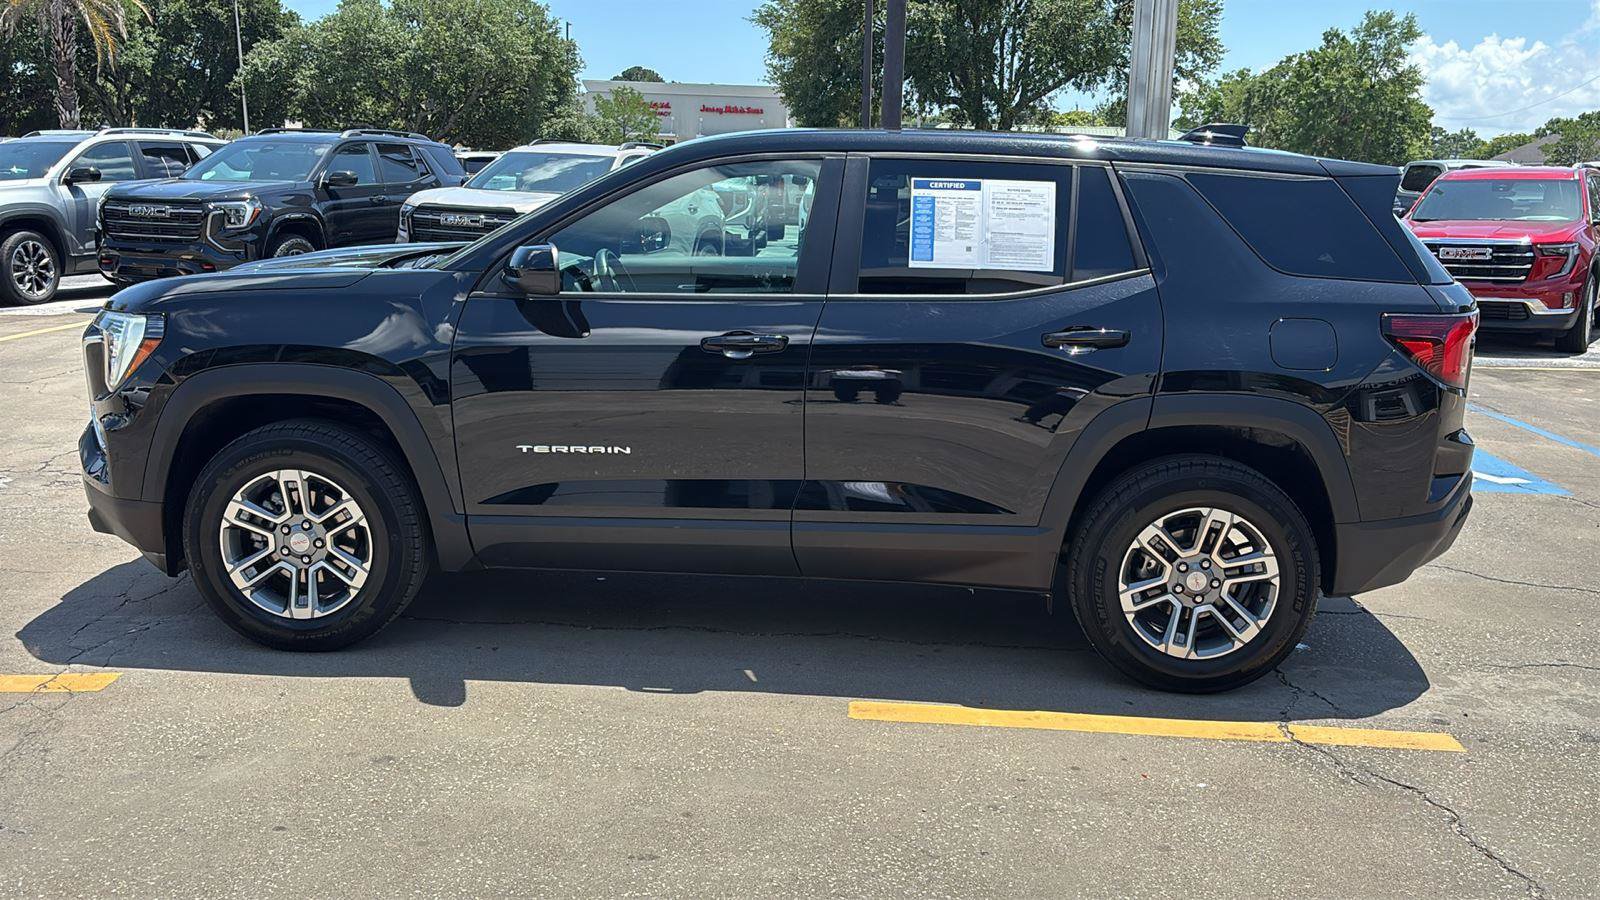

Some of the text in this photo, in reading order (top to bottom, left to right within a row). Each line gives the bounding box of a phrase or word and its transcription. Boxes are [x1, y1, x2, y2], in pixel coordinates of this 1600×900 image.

[129, 204, 170, 217] GMC
[440, 213, 484, 227] GMC
[1439, 247, 1492, 260] GMC
[516, 445, 631, 454] TERRAIN
